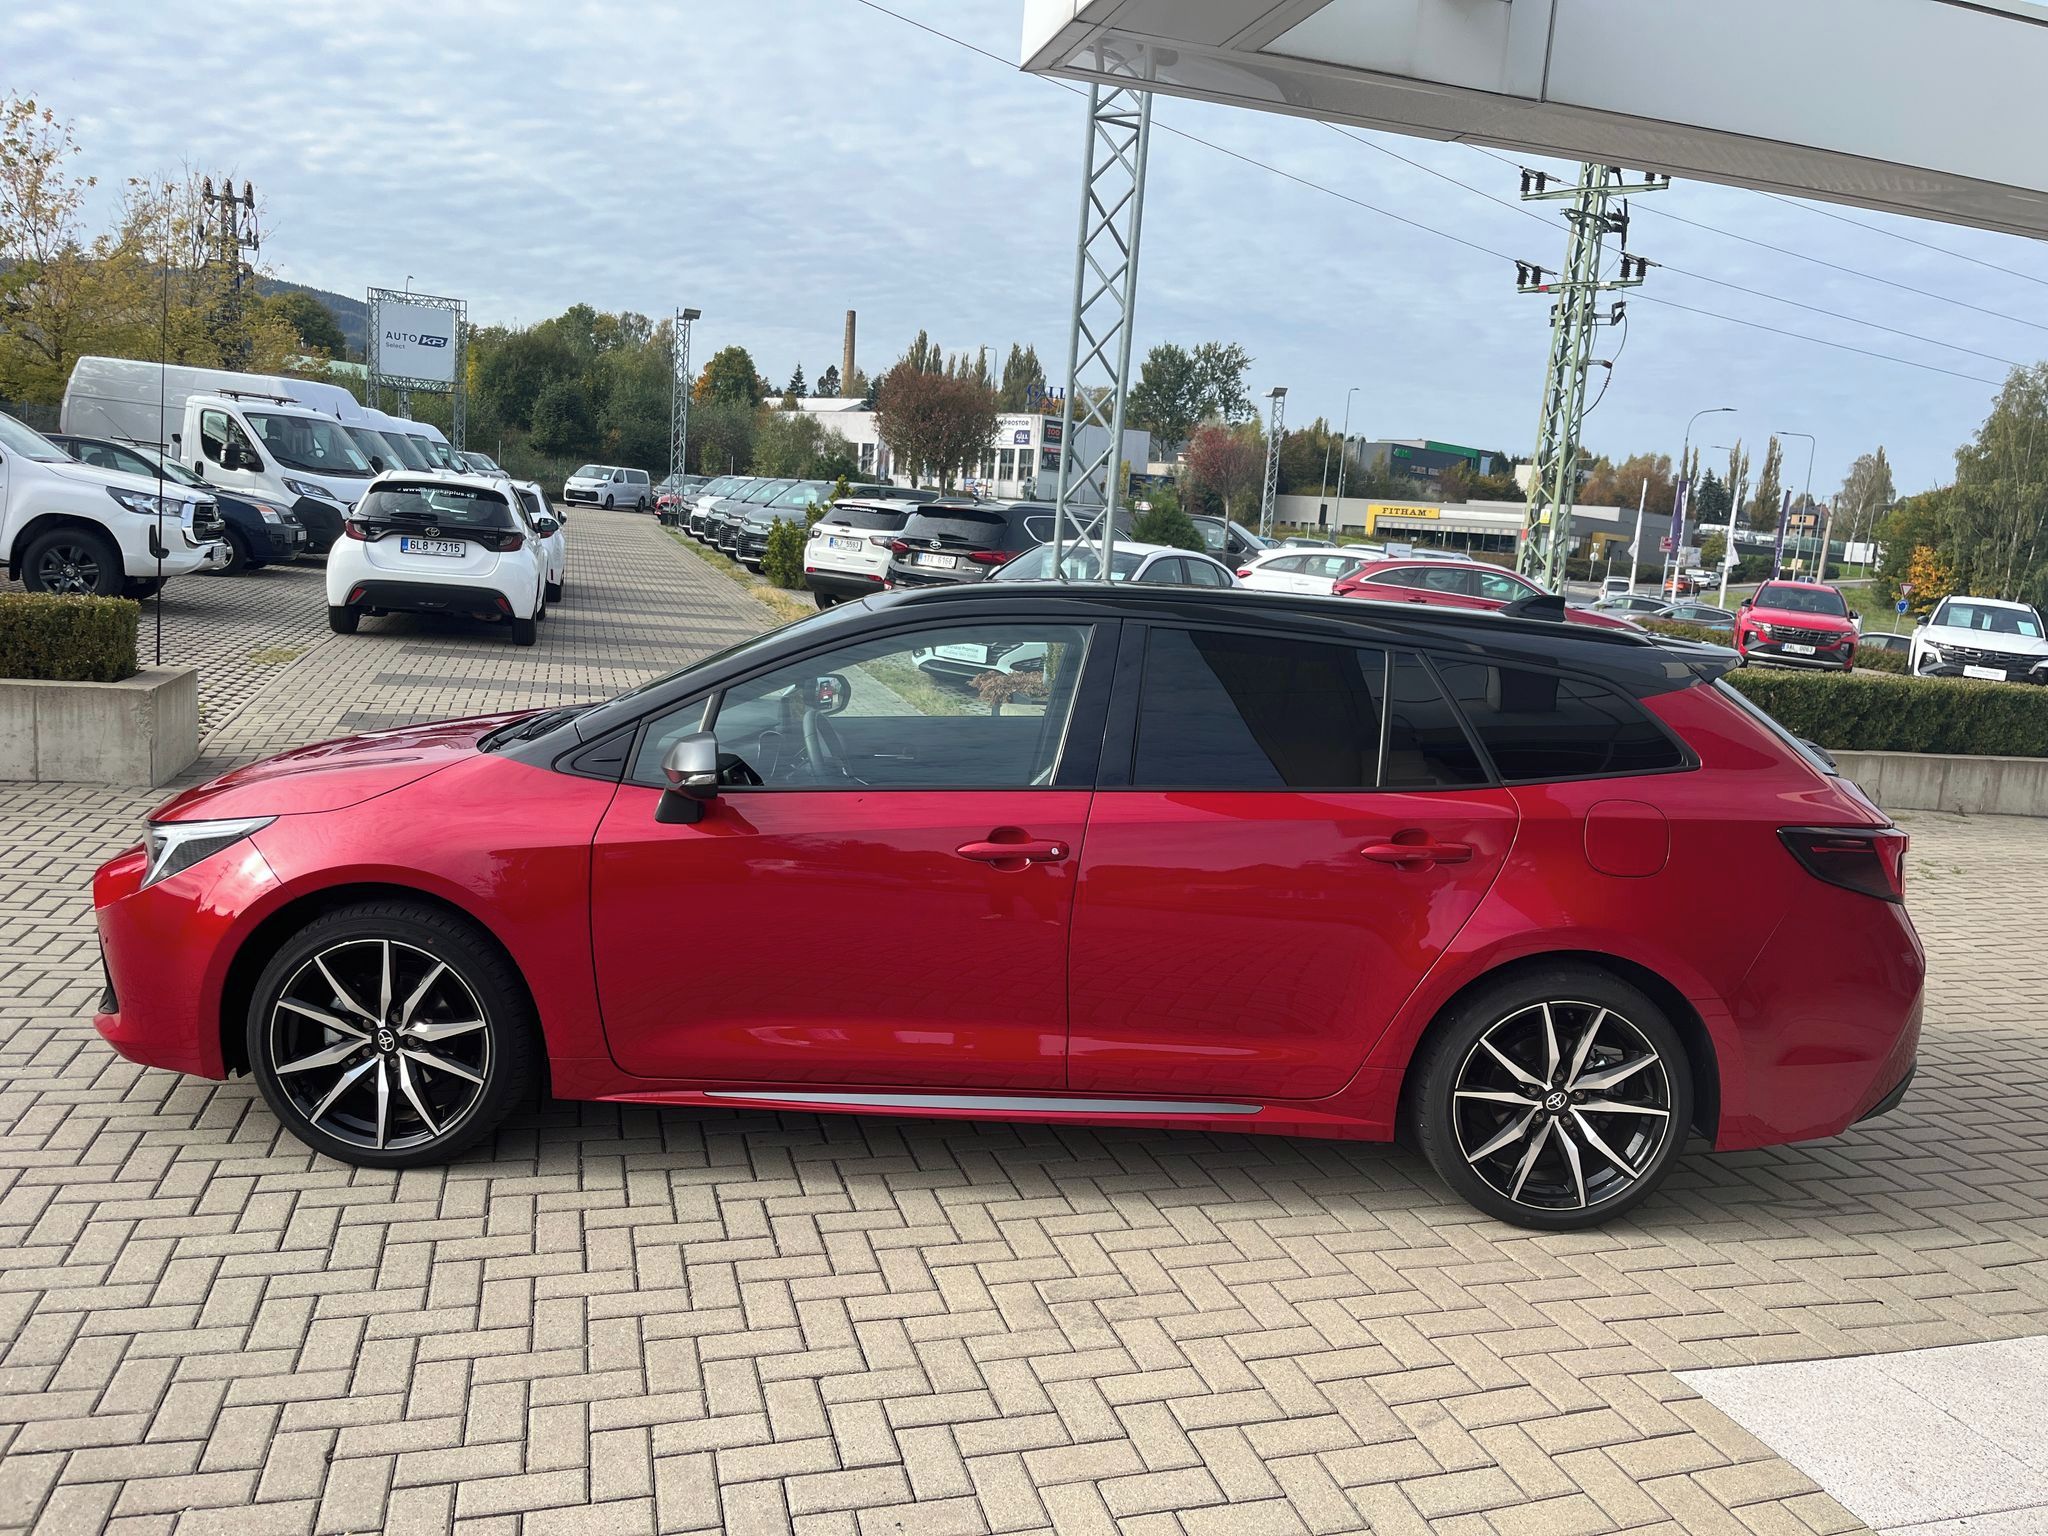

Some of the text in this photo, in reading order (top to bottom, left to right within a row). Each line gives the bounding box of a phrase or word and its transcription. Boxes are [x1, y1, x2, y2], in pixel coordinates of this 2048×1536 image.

[385, 331, 418, 343] AUTO
[385, 342, 406, 350] Select
[1382, 507, 1427, 517] FITHAM
[410, 540, 461, 553] 6L8 7315
